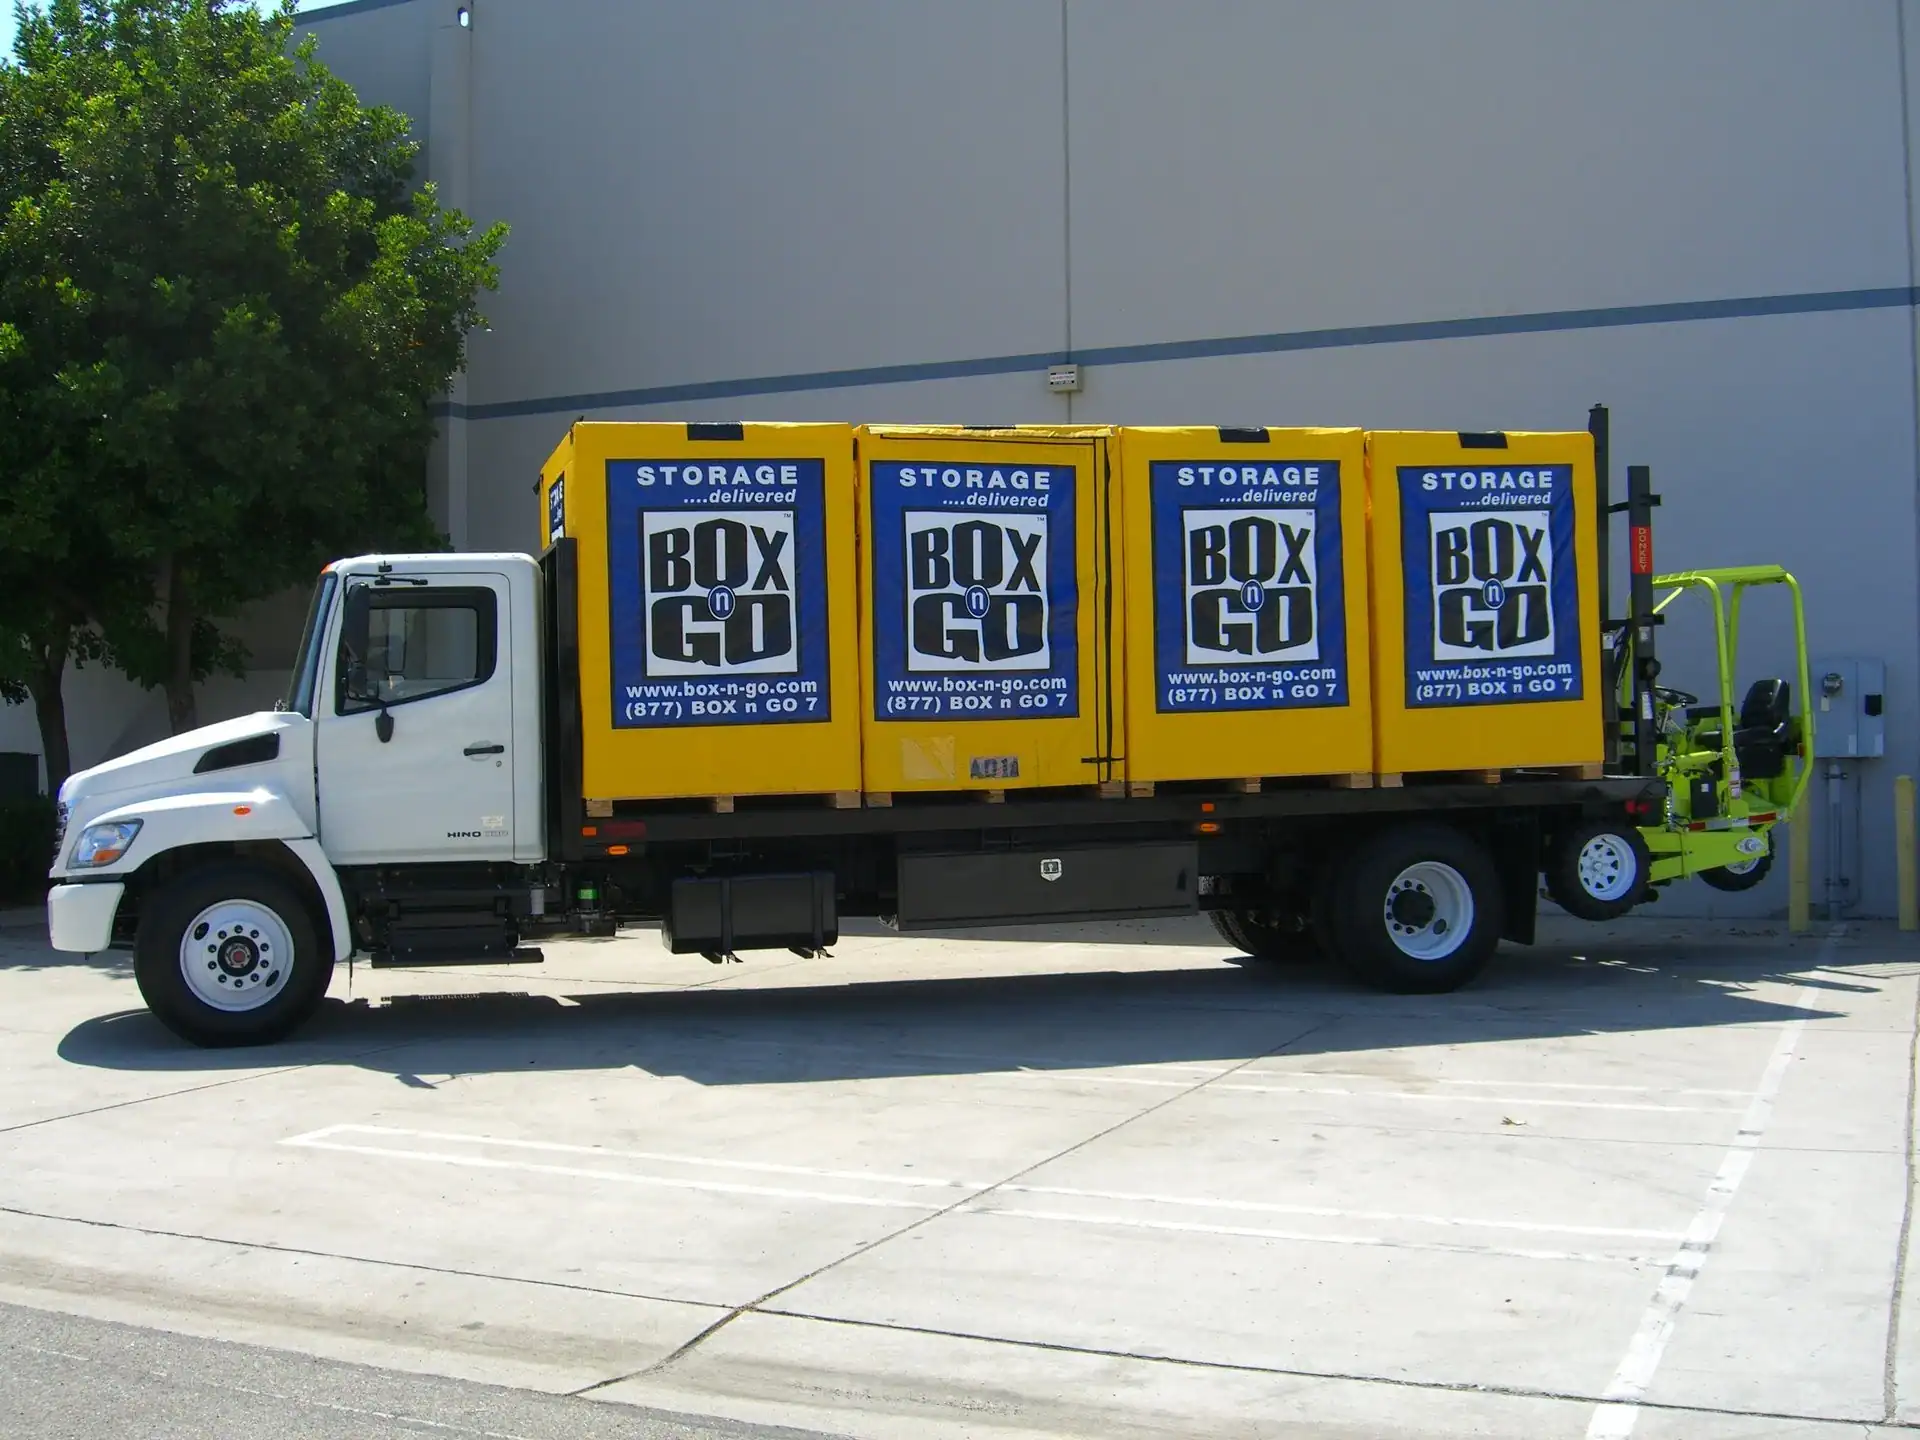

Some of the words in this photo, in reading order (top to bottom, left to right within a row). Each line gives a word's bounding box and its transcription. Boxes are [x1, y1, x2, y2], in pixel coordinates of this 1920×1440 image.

[637, 465, 798, 486] STORAGE
[899, 467, 1051, 490] STORAGE
[1177, 467, 1319, 486] STORAGE
[1422, 471, 1553, 491] STORAGE
[650, 518, 790, 593] BOX
[910, 520, 1042, 592] BOX
[1189, 516, 1312, 586] BOX
[1436, 518, 1547, 586] BOX
[913, 593, 1044, 663] GO
[1191, 586, 1313, 655] GO
[1438, 584, 1550, 651] GO
[651, 593, 792, 667] GO
[1168, 667, 1336, 685] www.box-n-go.com
[1416, 662, 1572, 682] www.box-n-go.com
[626, 679, 817, 699] www.box-n-go.com
[888, 675, 1067, 694] www.box-n-go.com
[1168, 687, 1217, 706] (877)
[1224, 686, 1266, 701] BOX
[1272, 687, 1284, 699] n
[1291, 684, 1319, 698] GO
[1326, 683, 1337, 697] 7
[1416, 682, 1462, 700] (877)
[1468, 681, 1507, 696] BOX
[1513, 682, 1523, 694] n
[1528, 679, 1556, 693] GO
[1562, 677, 1573, 691] 7
[626, 701, 682, 720] (877)
[691, 700, 737, 716] BOX
[745, 701, 757, 713] n
[766, 698, 798, 713] GO
[806, 697, 818, 711] 7
[886, 695, 942, 713] (877)
[950, 695, 993, 710] BOX
[1000, 696, 1012, 708] n
[1019, 694, 1047, 709] GO
[1056, 693, 1067, 707] 7
